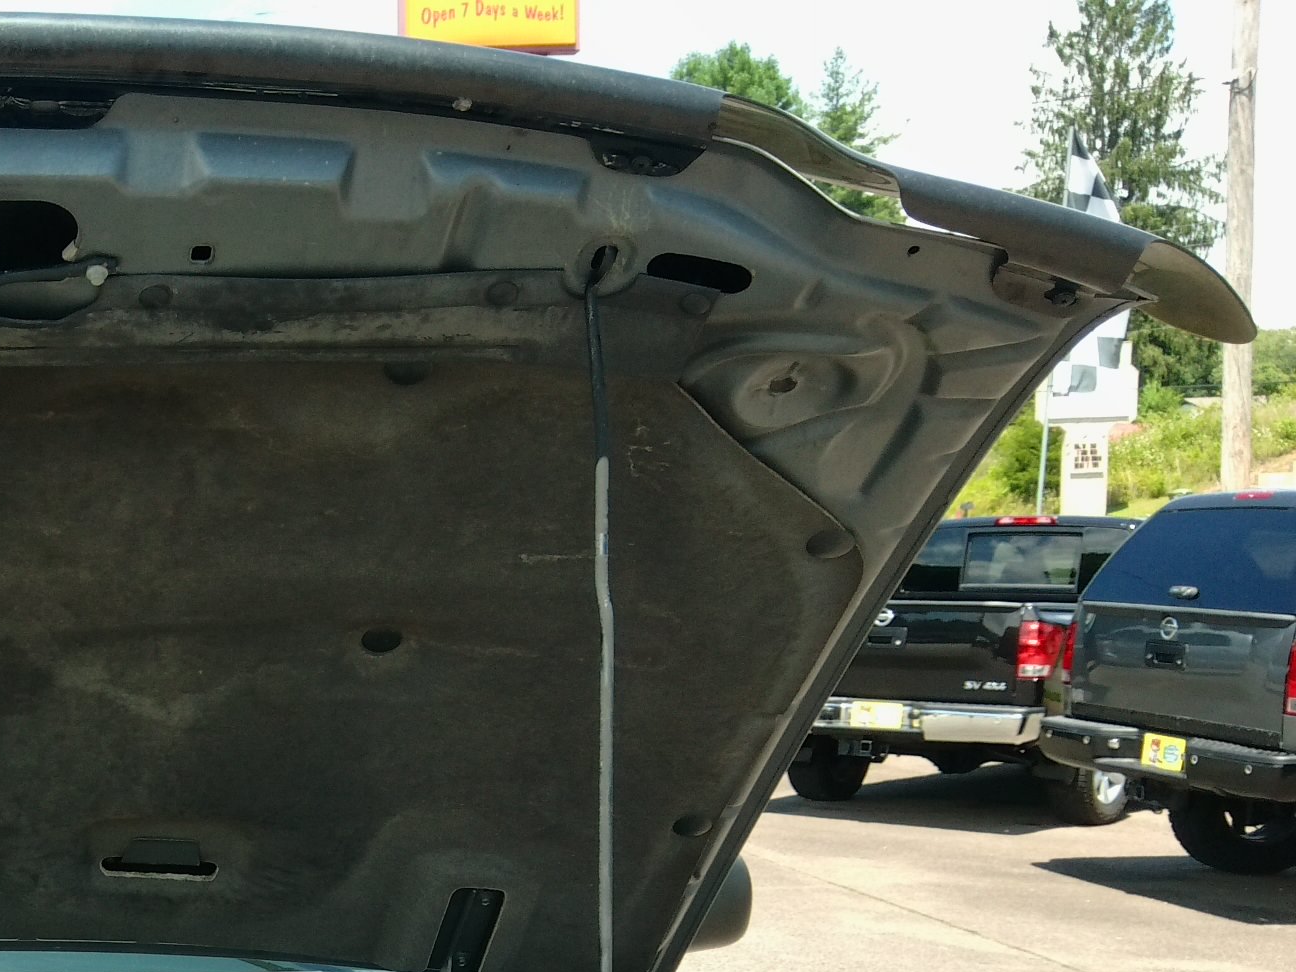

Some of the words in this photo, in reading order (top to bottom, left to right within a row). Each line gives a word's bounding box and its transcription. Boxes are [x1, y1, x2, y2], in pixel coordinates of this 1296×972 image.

[420, 7, 456, 29] Open
[460, 2, 470, 18] 7
[475, 0, 506, 21] Days
[511, 7, 519, 18] a
[524, 4, 564, 22] Week!
